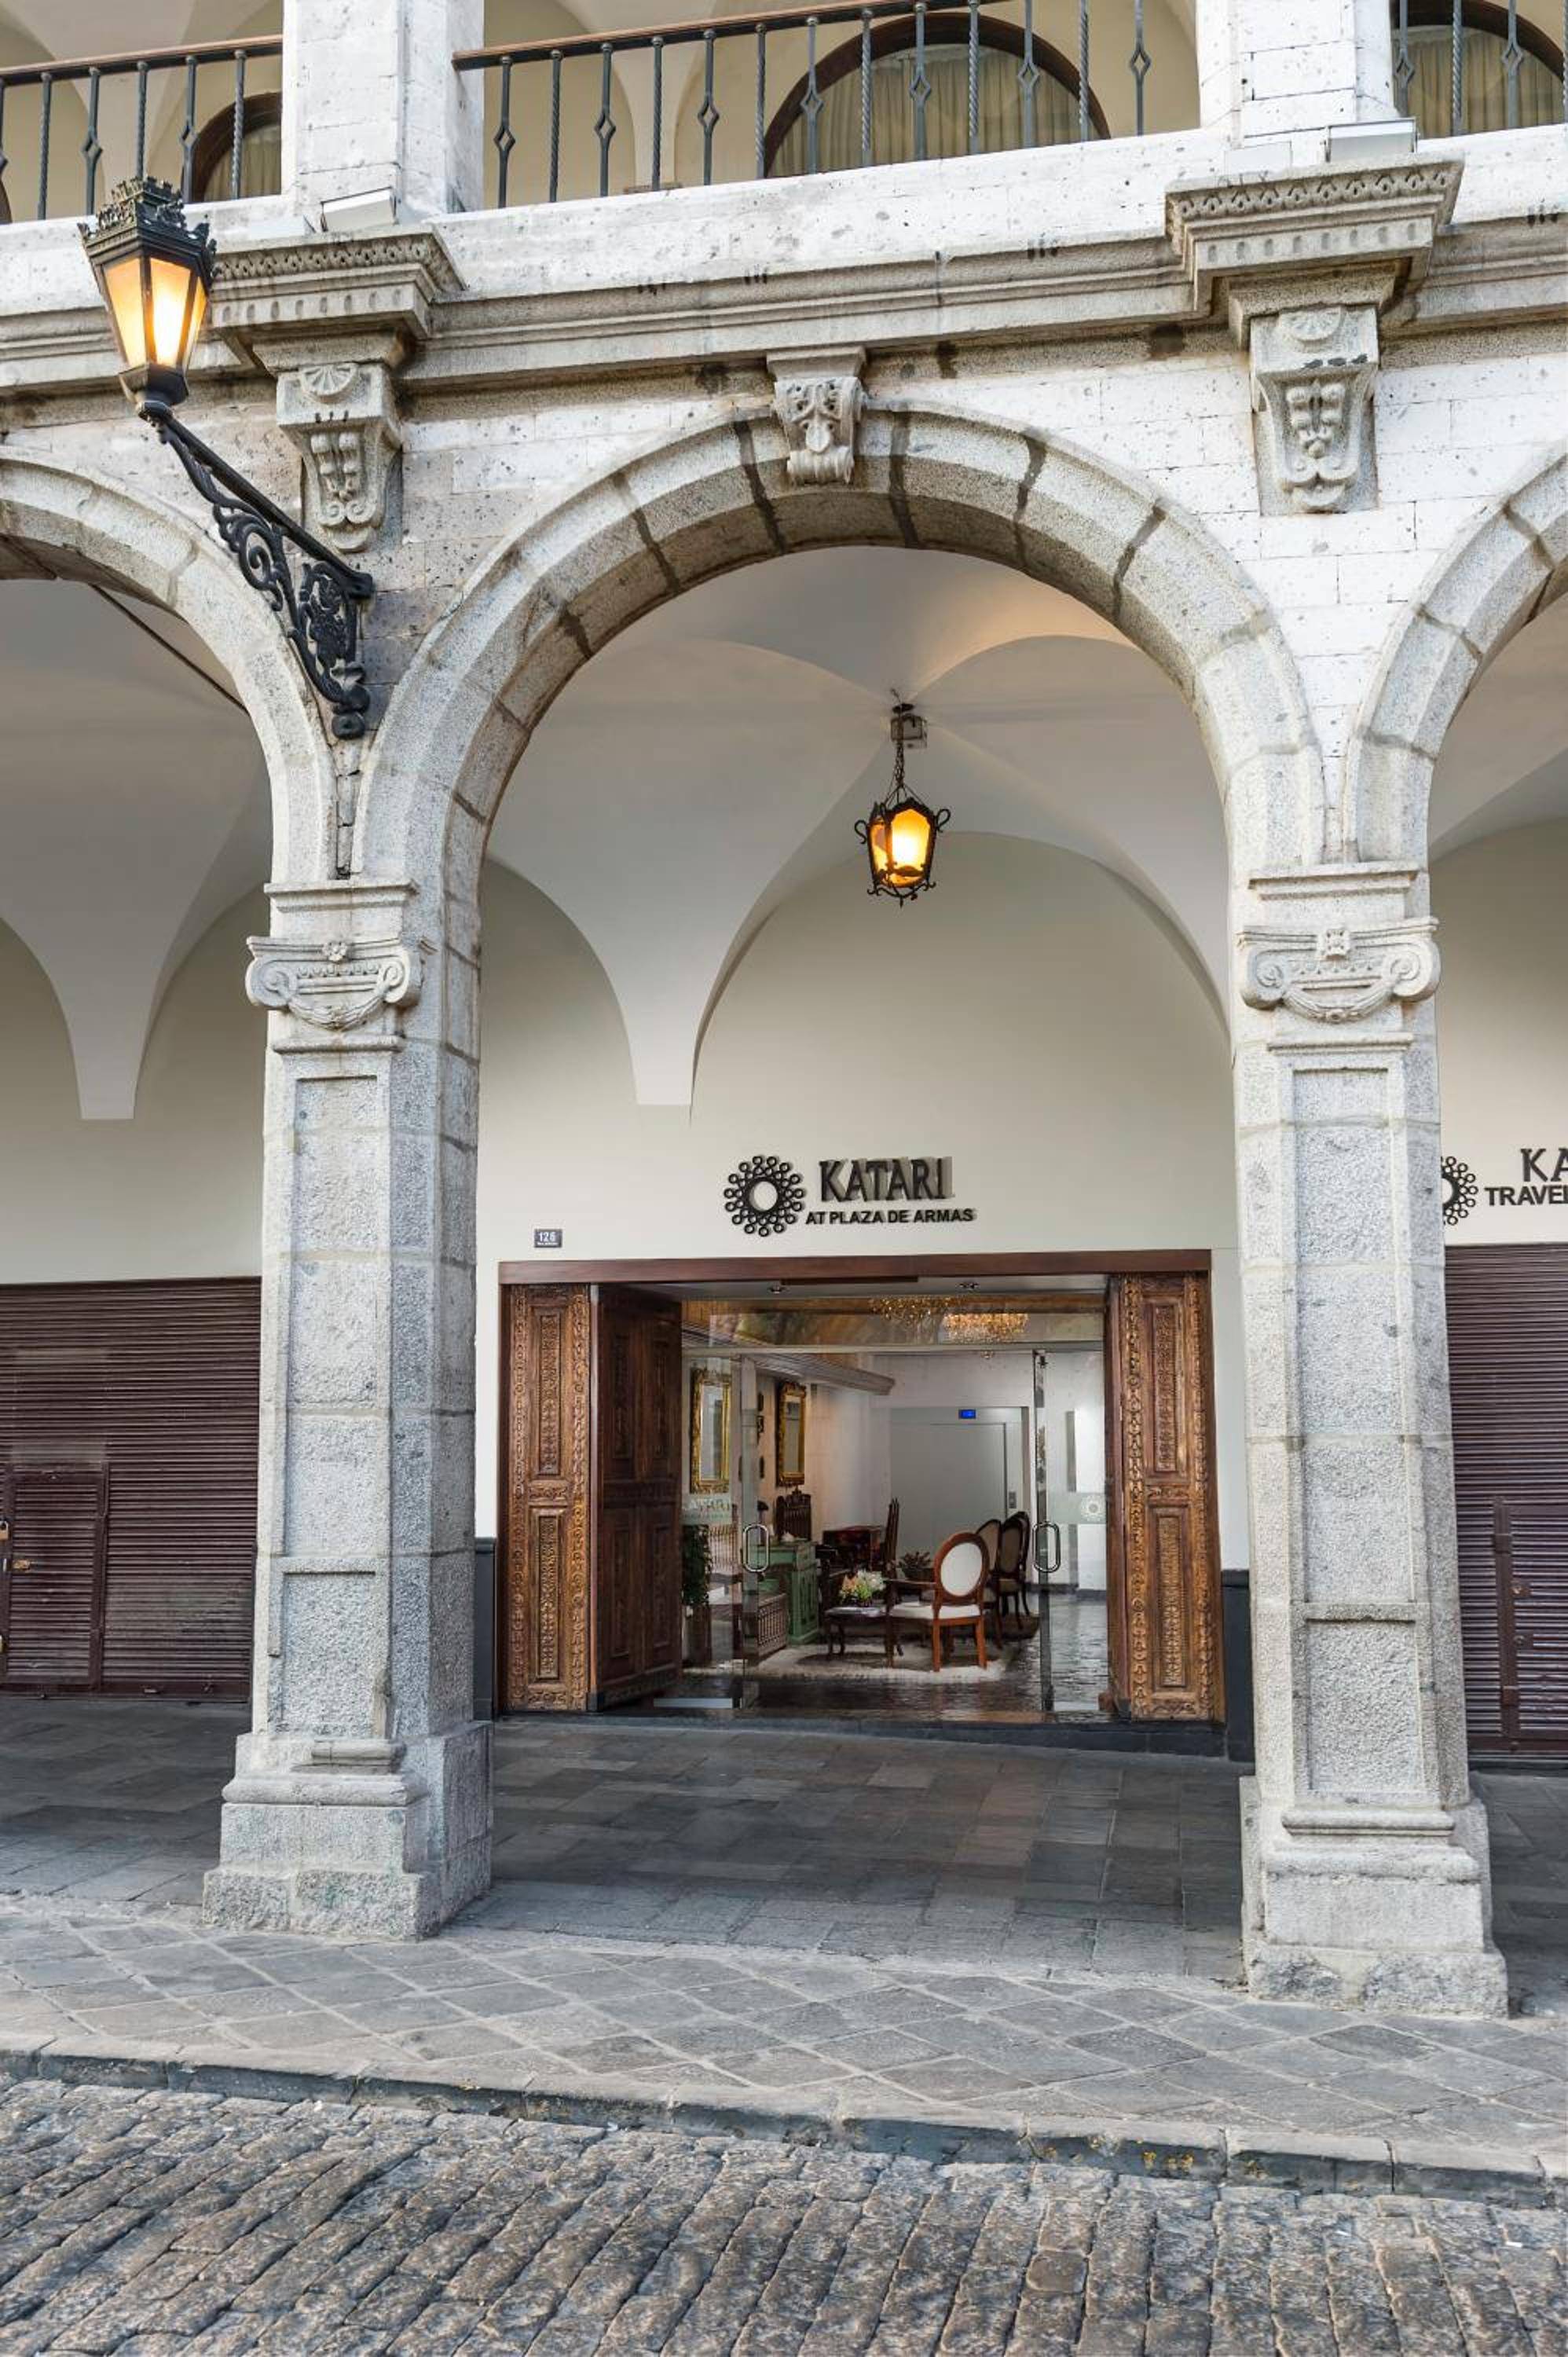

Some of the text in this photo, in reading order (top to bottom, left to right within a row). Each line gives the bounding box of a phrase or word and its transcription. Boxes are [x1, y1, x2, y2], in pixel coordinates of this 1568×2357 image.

[819, 1157, 951, 1202] KATARI
[1520, 1147, 1568, 1182] KA
[805, 1208, 975, 1225] AT PLAZA DE ARMAS
